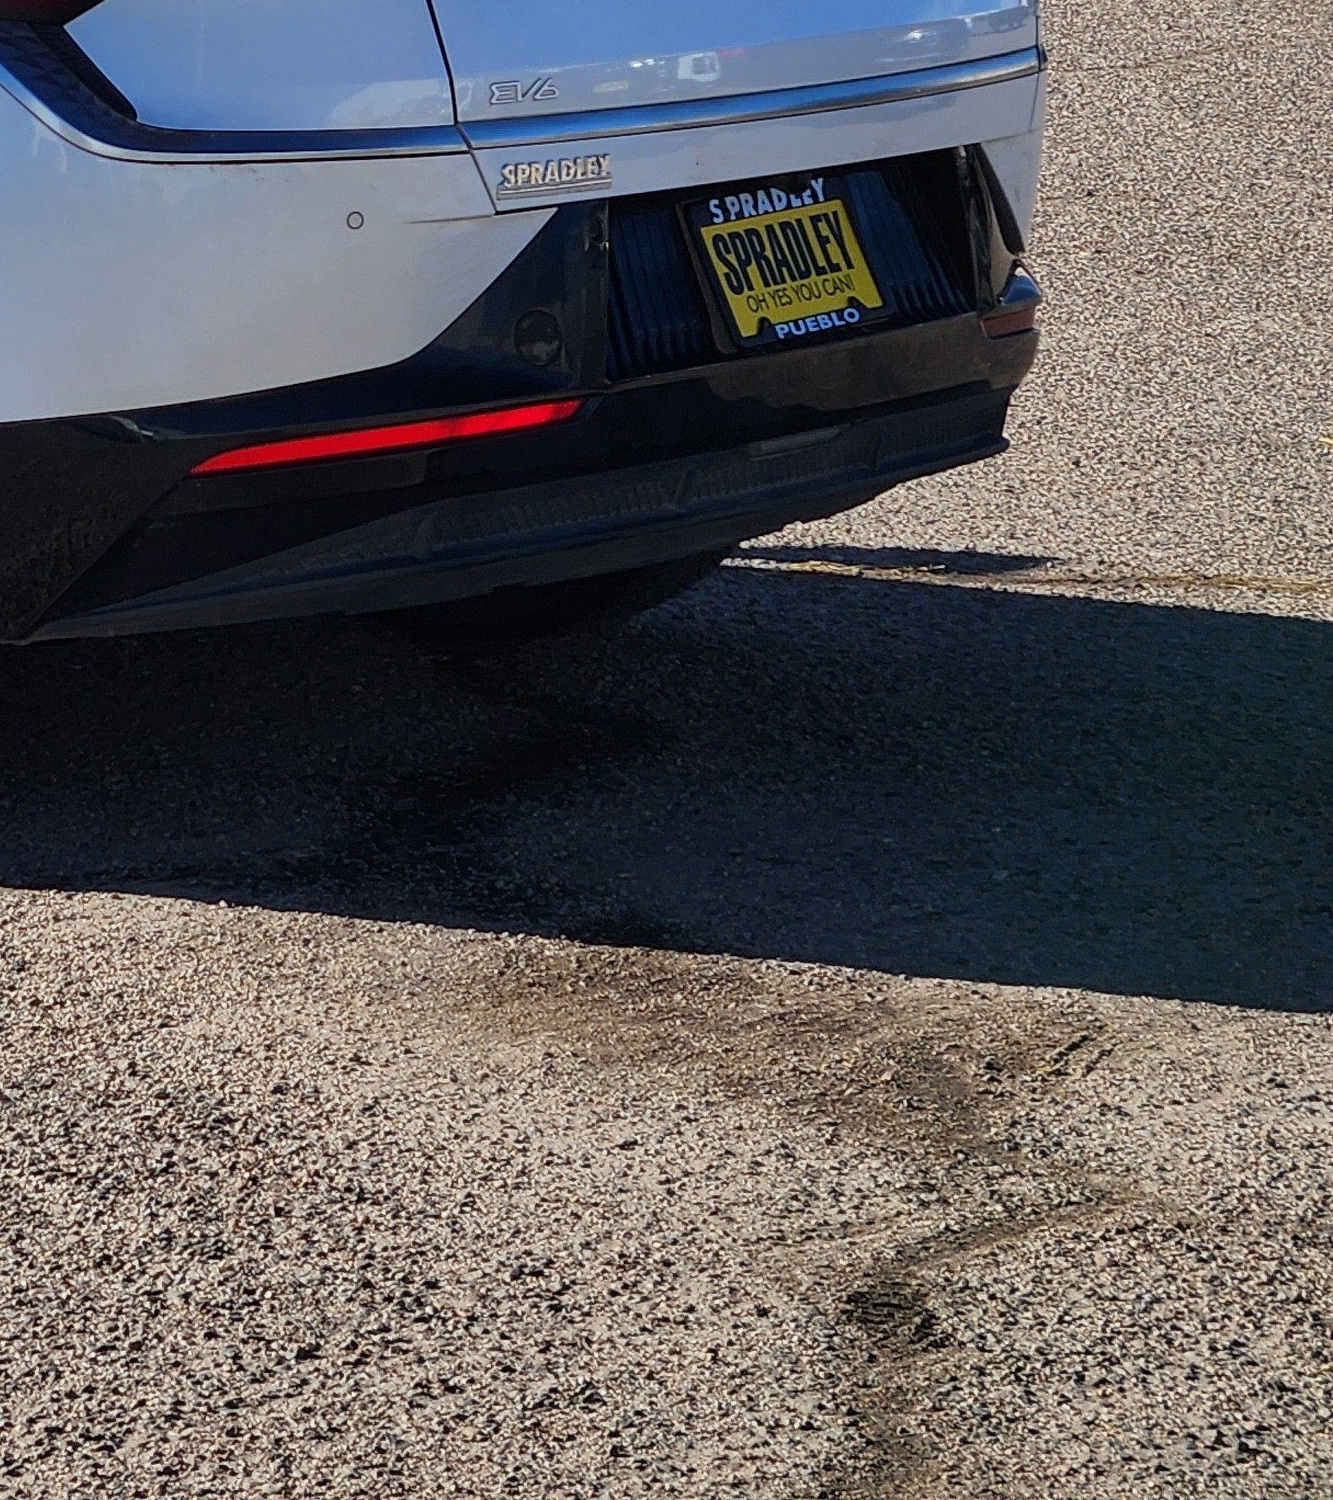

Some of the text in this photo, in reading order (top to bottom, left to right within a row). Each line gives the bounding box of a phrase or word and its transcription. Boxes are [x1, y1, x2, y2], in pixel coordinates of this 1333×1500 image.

[489, 77, 559, 107] EV6
[500, 153, 611, 189] SPRADLEY
[708, 177, 825, 224] SPRADLEY
[712, 210, 855, 296] SPRADLEY
[746, 273, 856, 314] OH YES YOU CAN!
[774, 307, 860, 339] PUEBLO
